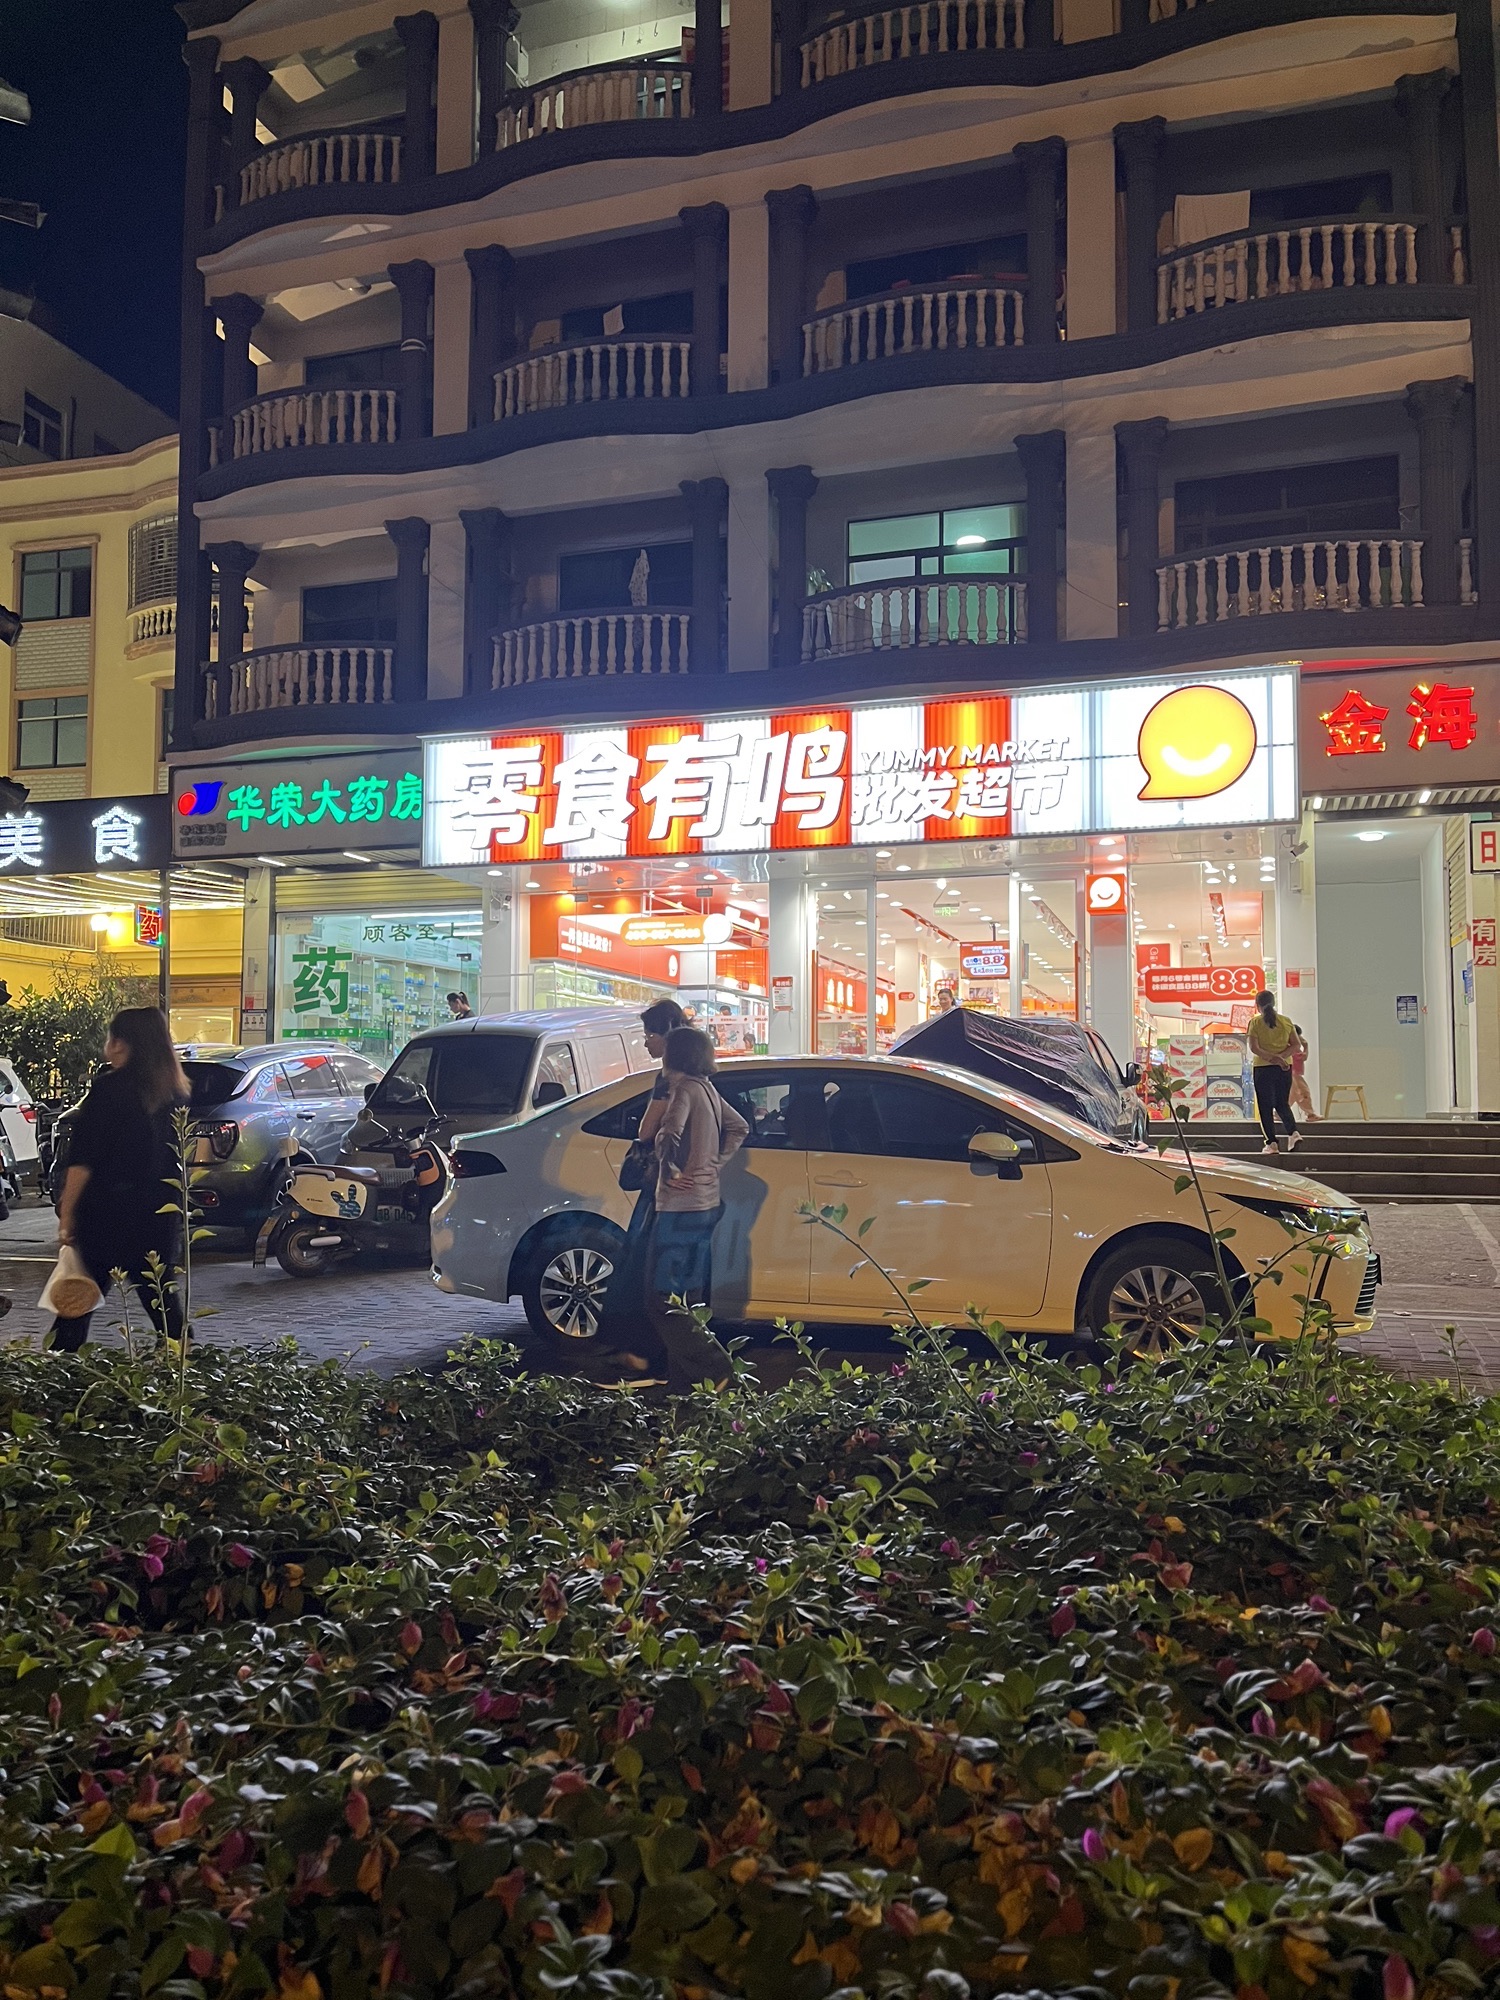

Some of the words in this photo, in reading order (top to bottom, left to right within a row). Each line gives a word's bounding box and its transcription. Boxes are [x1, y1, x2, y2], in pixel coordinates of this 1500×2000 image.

[861, 744, 957, 773] YUMMY
[960, 736, 1070, 766] MARKET
[227, 772, 422, 832] 华荣大药房
[451, 725, 848, 850] 零食有鸣
[851, 765, 1069, 826] 批发超市
[140, 908, 160, 939] 药
[363, 922, 465, 943] 顾客至上
[1473, 920, 1496, 965] 有房
[292, 946, 353, 1014] 药
[1211, 968, 1257, 995] 88
